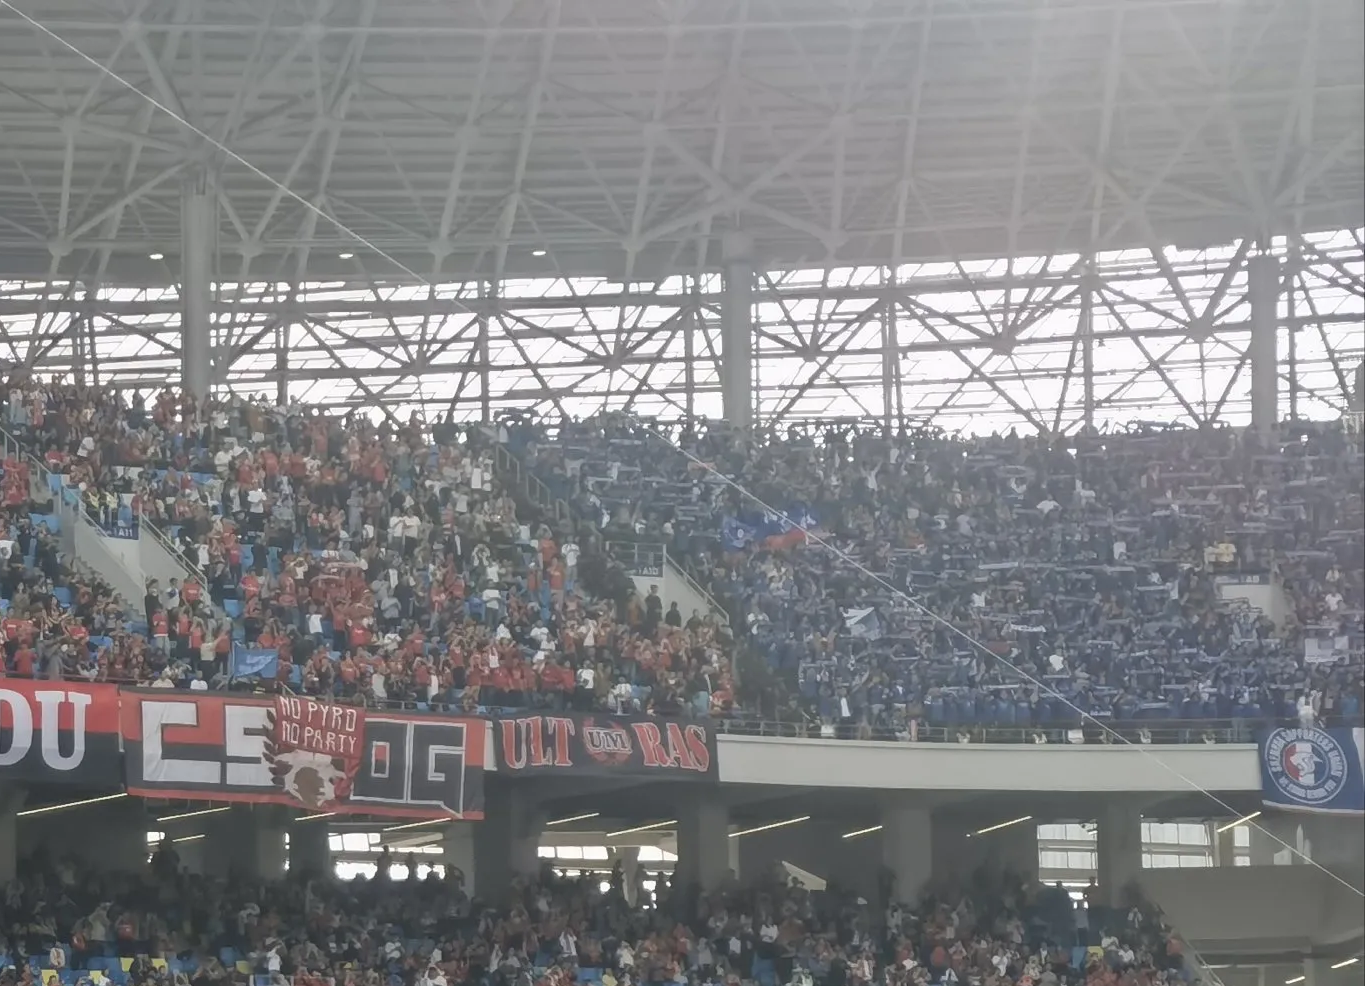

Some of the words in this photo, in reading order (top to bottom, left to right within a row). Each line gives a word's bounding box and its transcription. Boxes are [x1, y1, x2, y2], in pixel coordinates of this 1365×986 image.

[279, 697, 301, 719] NO
[307, 702, 358, 733] PYRO
[281, 721, 301, 744] NO
[304, 726, 358, 754] PARTY
